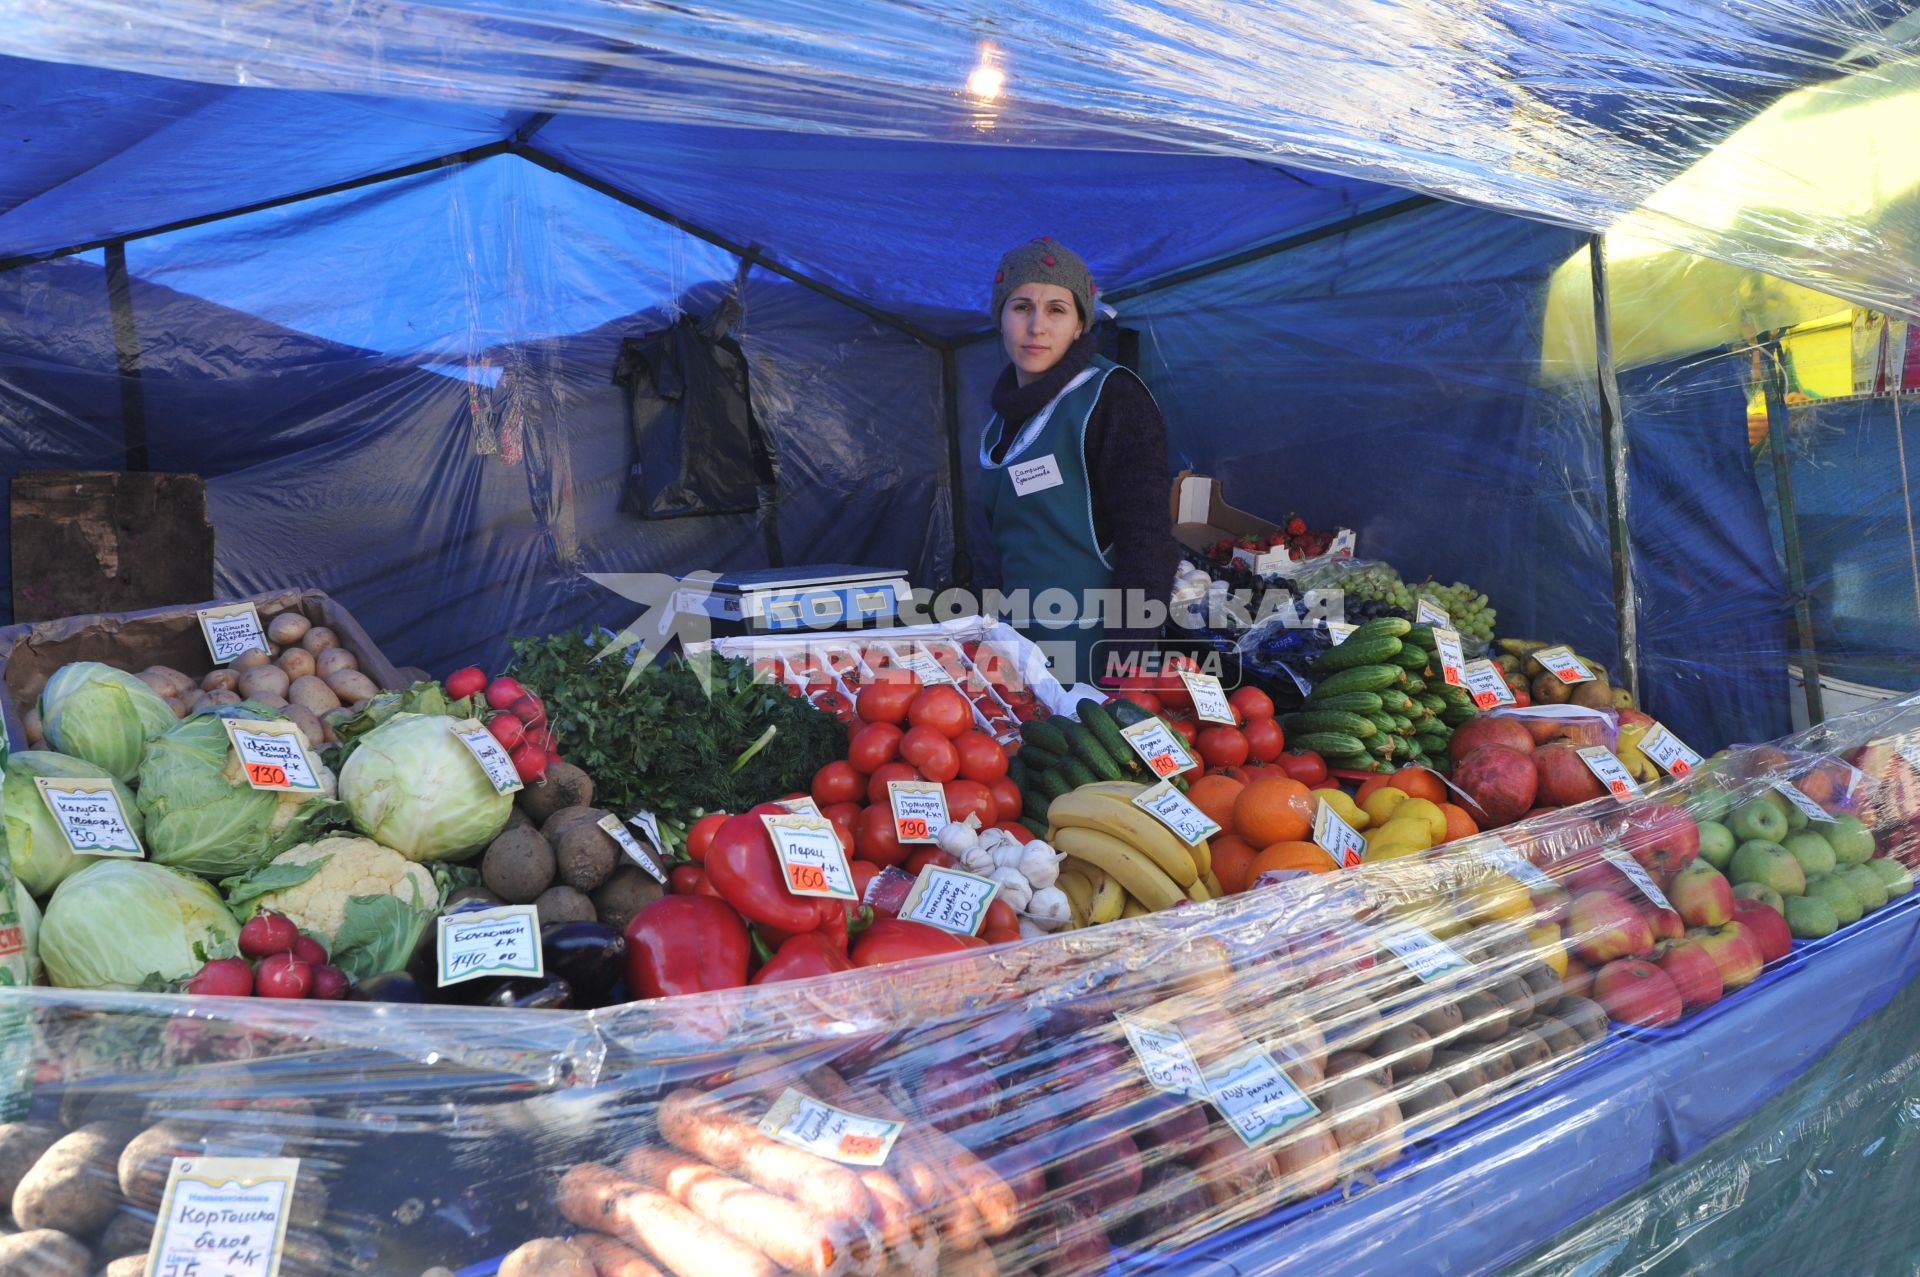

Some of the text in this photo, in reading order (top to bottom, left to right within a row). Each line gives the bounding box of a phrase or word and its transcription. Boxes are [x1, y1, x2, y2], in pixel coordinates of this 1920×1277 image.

[252, 766, 285, 784] 130
[901, 801, 940, 810] Помидор
[70, 829, 96, 842] 30
[900, 821, 927, 836] 190
[1180, 823, 1195, 835] 50
[789, 844, 825, 859] Перец
[793, 866, 824, 887] 160
[952, 901, 972, 927] 130
[450, 952, 487, 972] 140
[1244, 1111, 1265, 1131] 25
